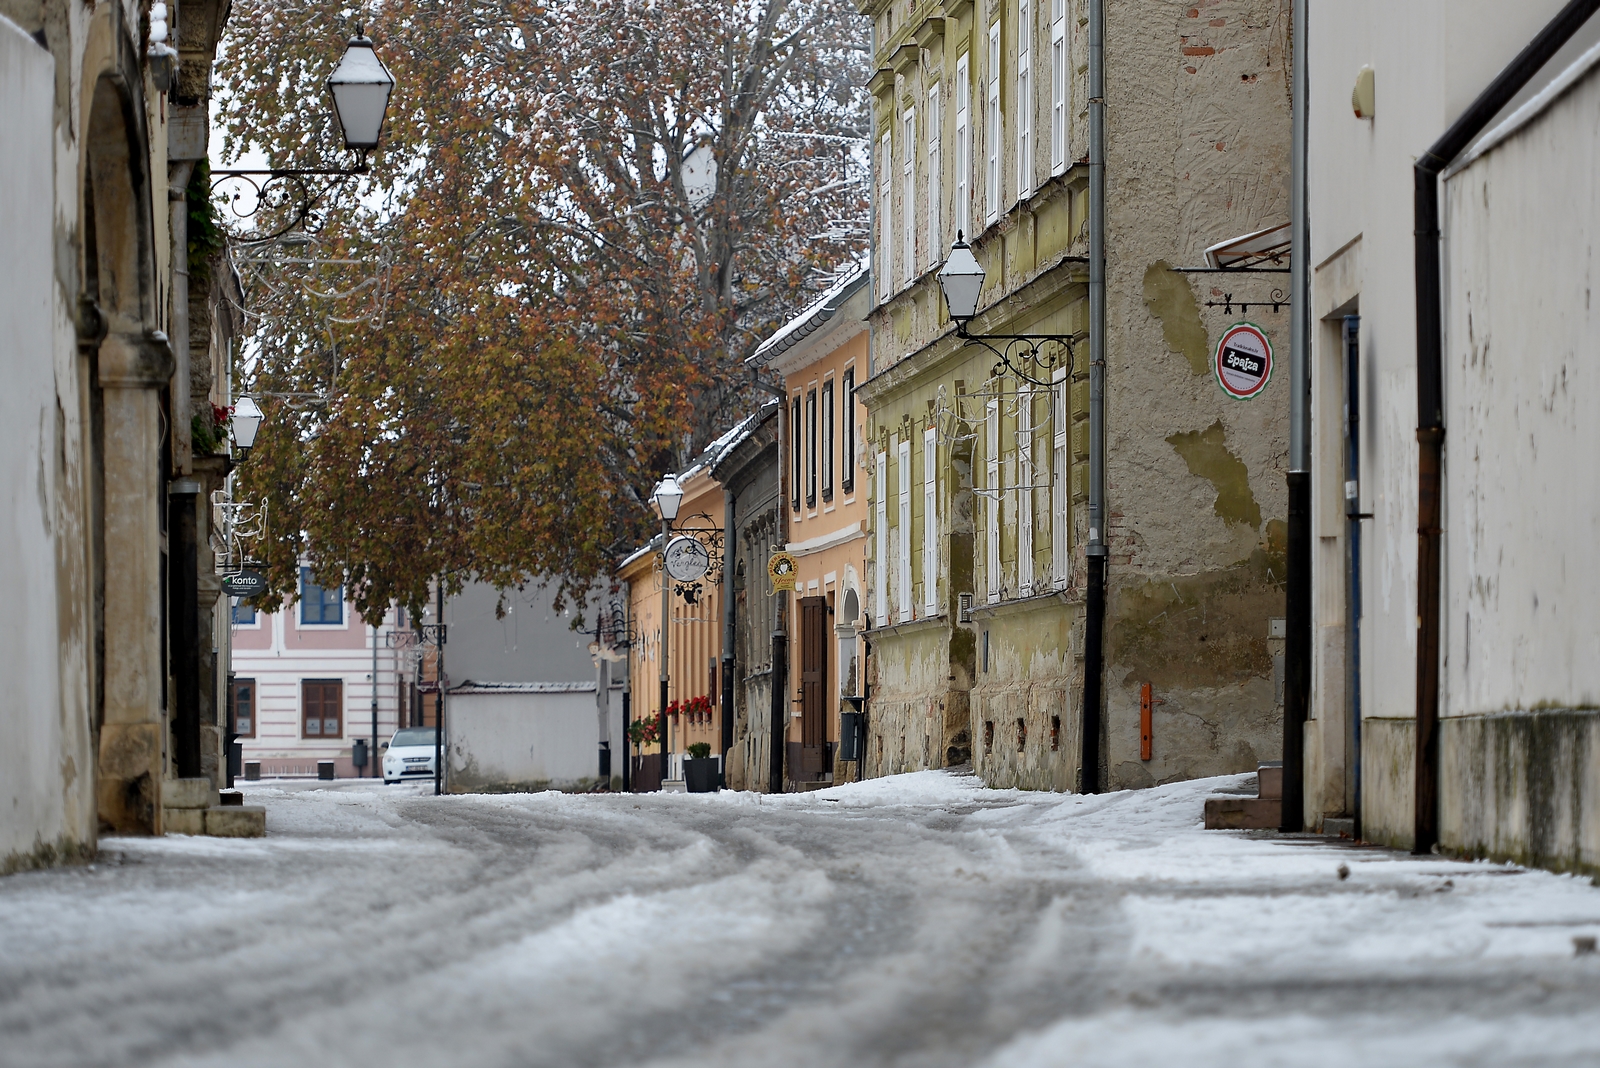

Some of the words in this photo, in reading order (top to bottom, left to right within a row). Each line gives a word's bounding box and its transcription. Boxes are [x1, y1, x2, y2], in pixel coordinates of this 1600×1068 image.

[1227, 351, 1259, 371] Špajza
[789, 557, 798, 577] SALON
[232, 576, 257, 585] konto
